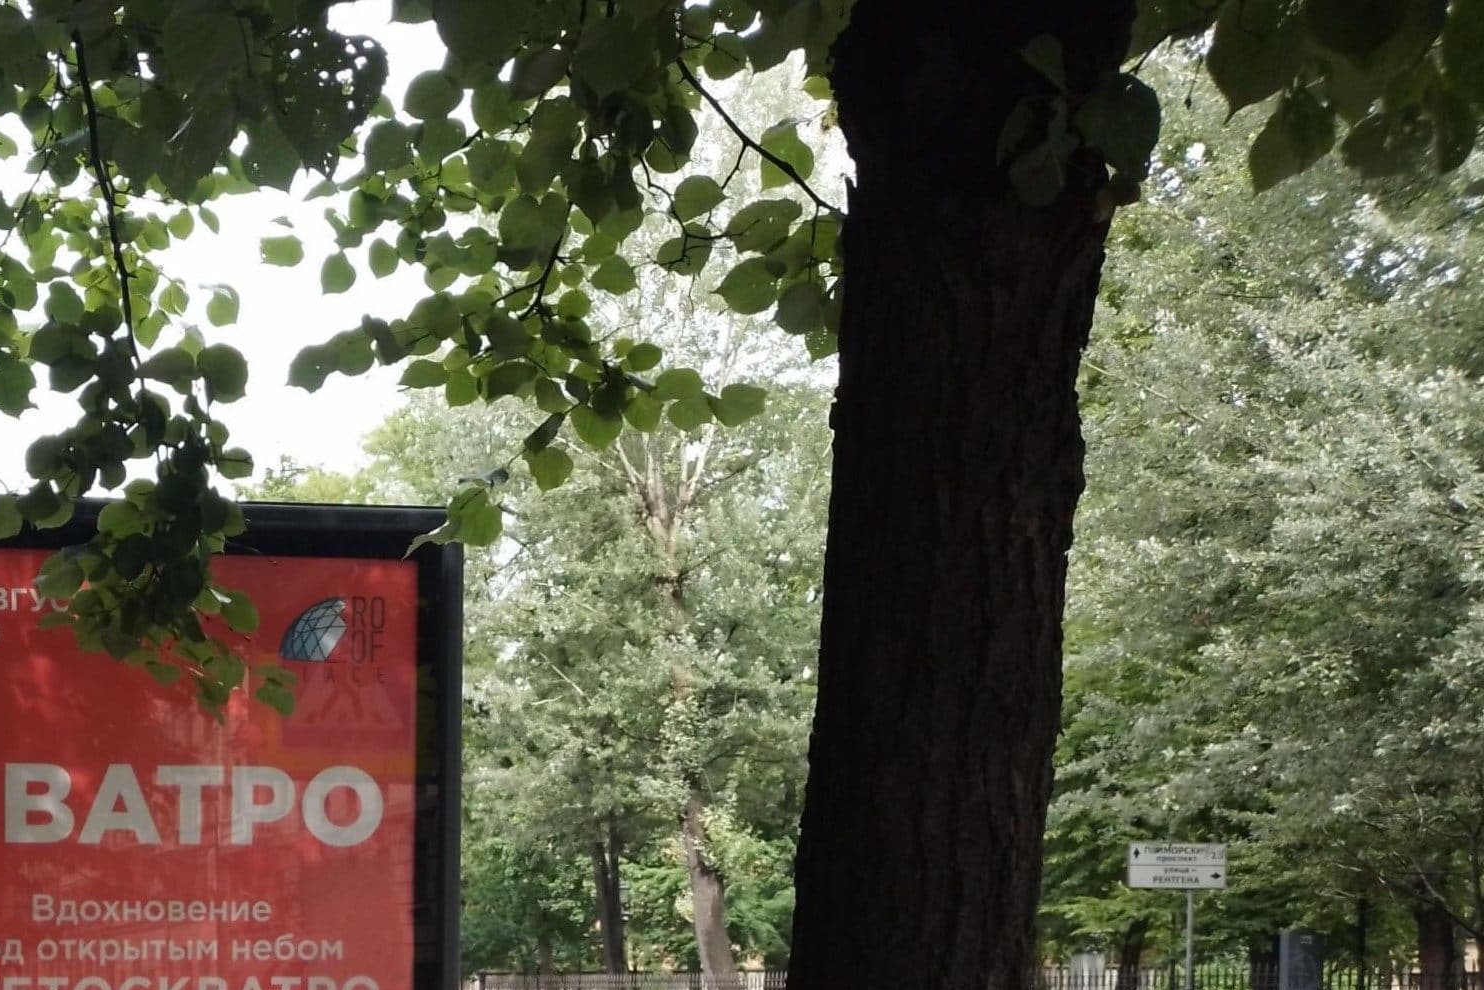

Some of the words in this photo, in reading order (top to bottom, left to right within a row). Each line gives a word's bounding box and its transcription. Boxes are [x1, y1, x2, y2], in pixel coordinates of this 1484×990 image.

[1153, 875, 1199, 884] РЕНТГЕНА
[31, 893, 273, 926] Вдохновение
[36, 938, 219, 967] открытым
[231, 932, 344, 961] небом
